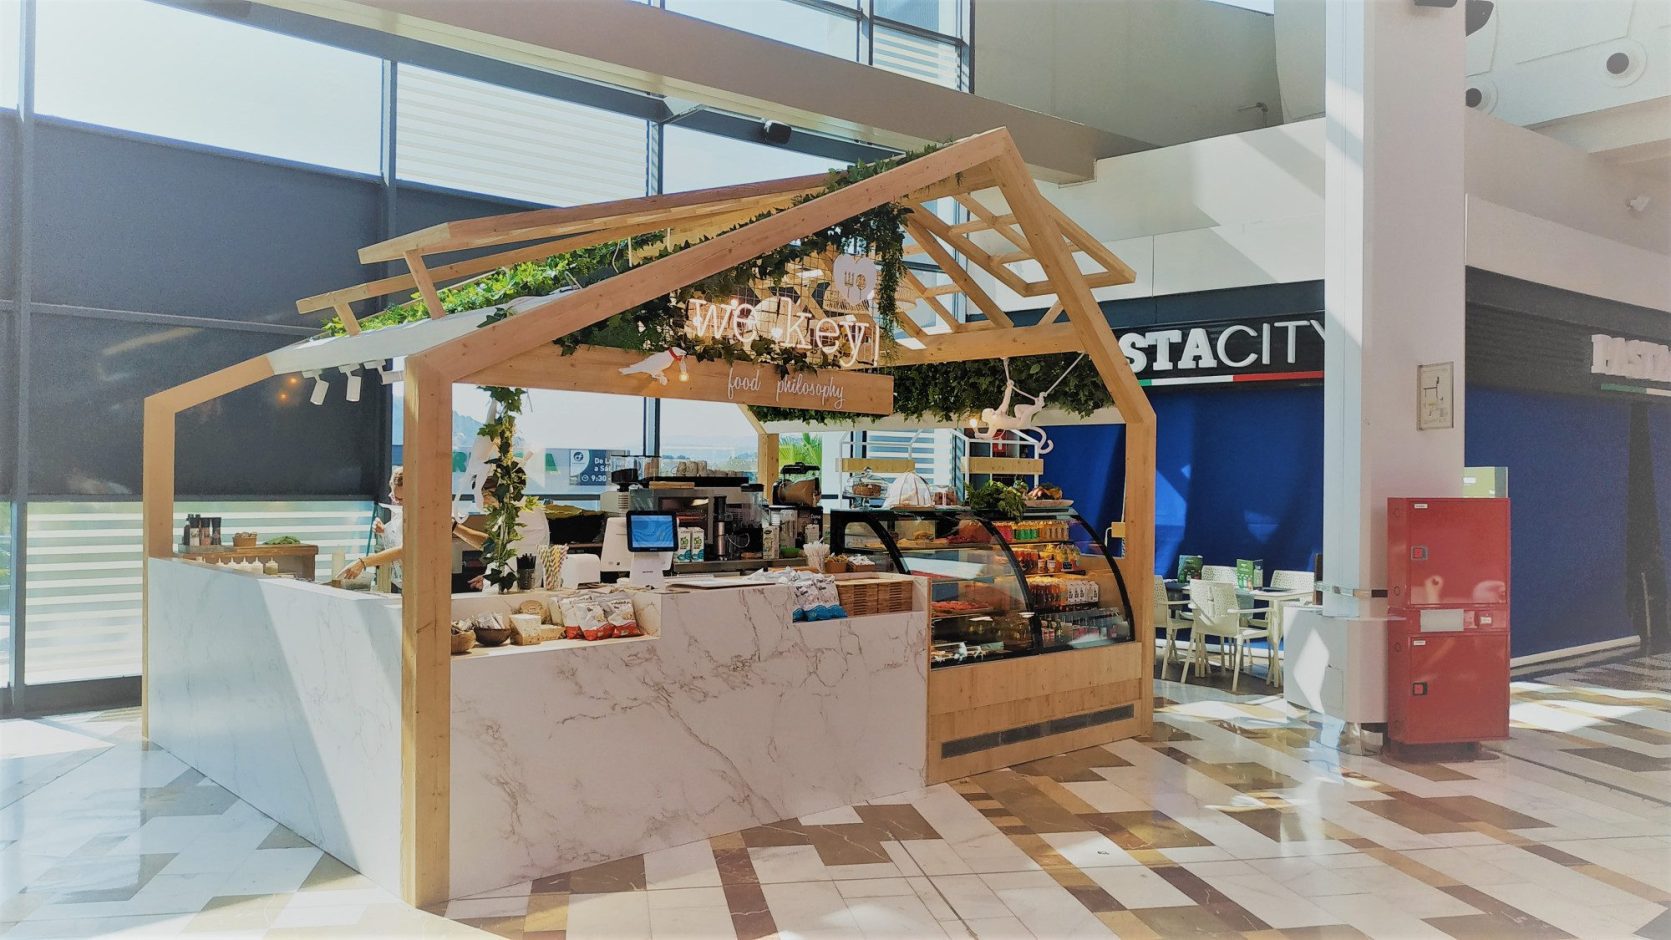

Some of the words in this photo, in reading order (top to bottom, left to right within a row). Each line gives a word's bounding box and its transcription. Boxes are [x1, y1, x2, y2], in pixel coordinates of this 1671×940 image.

[728, 367, 761, 400] food
[776, 373, 846, 410] philosophy
[594, 457, 604, 465] De
[591, 474, 607, 482] 9:30
